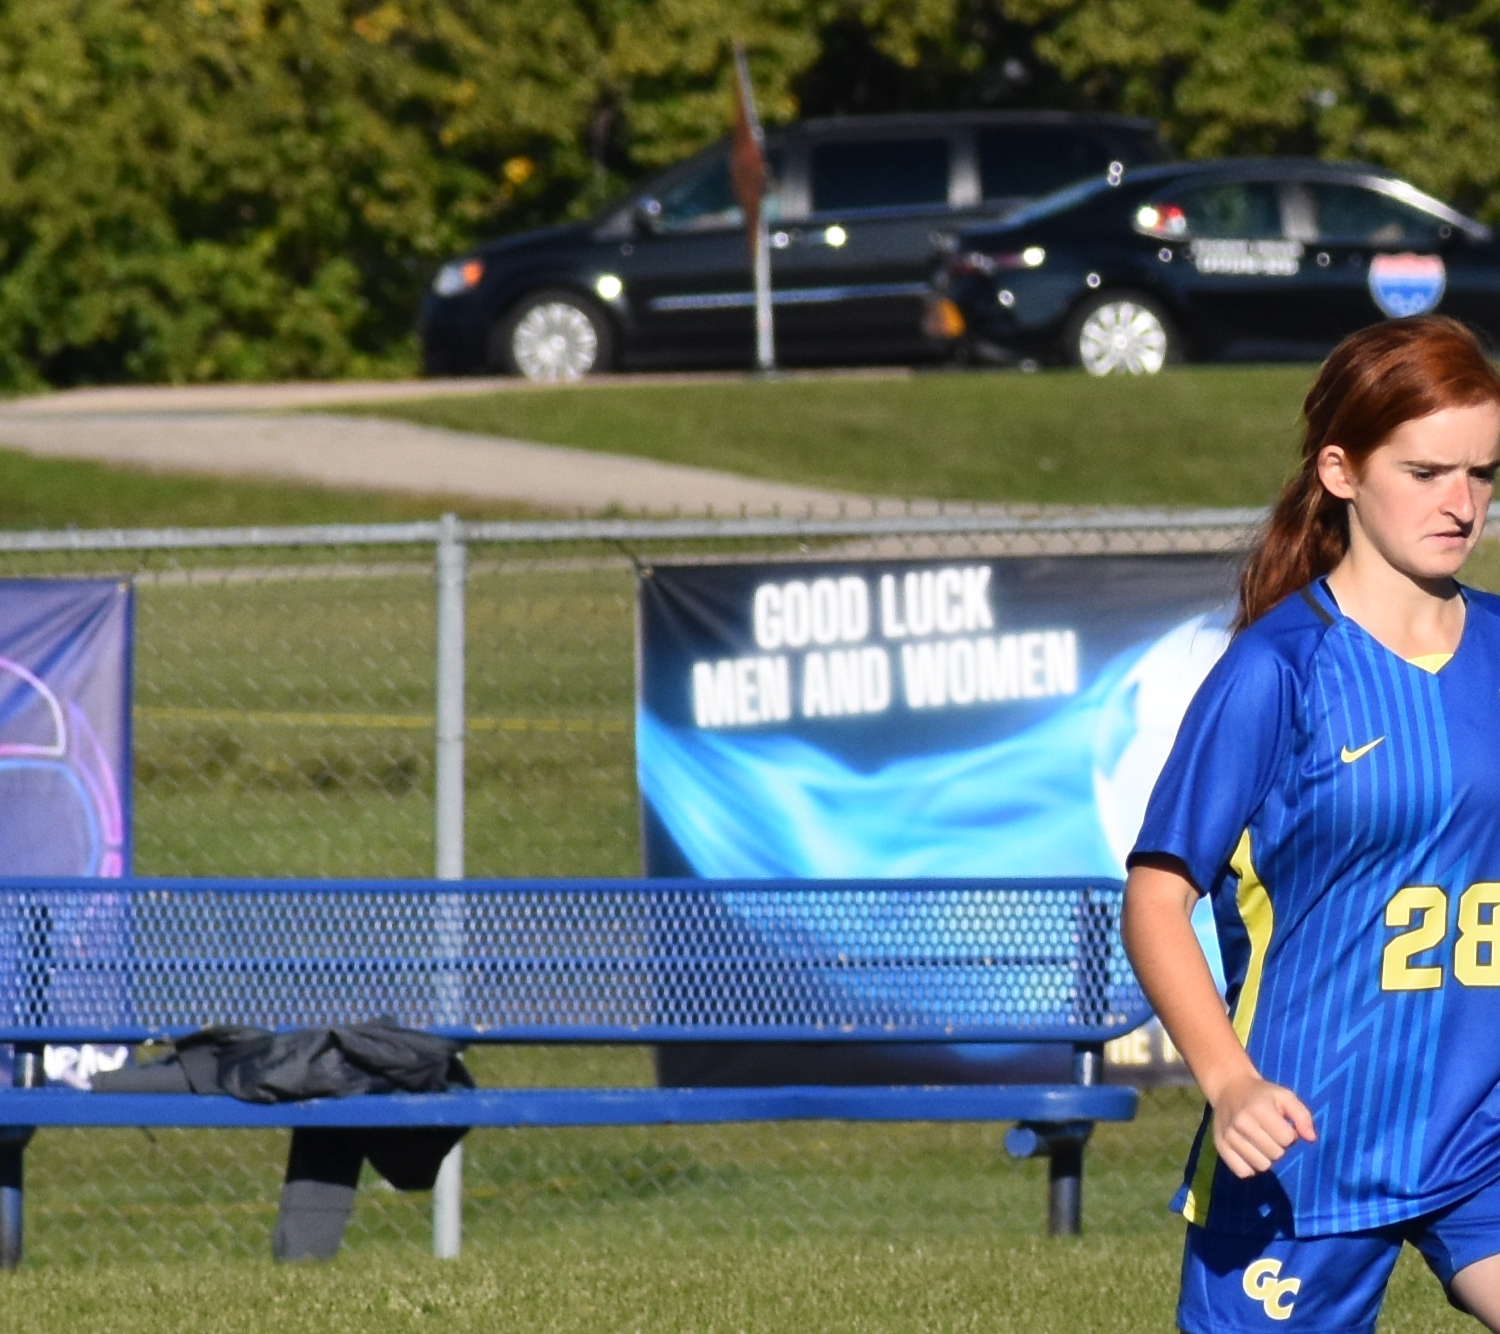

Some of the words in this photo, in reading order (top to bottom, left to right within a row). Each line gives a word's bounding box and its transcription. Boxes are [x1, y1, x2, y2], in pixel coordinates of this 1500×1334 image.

[753, 575, 870, 650] GOOD
[880, 565, 995, 638] LUCK
[692, 656, 791, 728] MEN
[803, 646, 891, 718] AND
[901, 630, 1079, 709] WOMEN
[1242, 1258, 1301, 1322] GC
